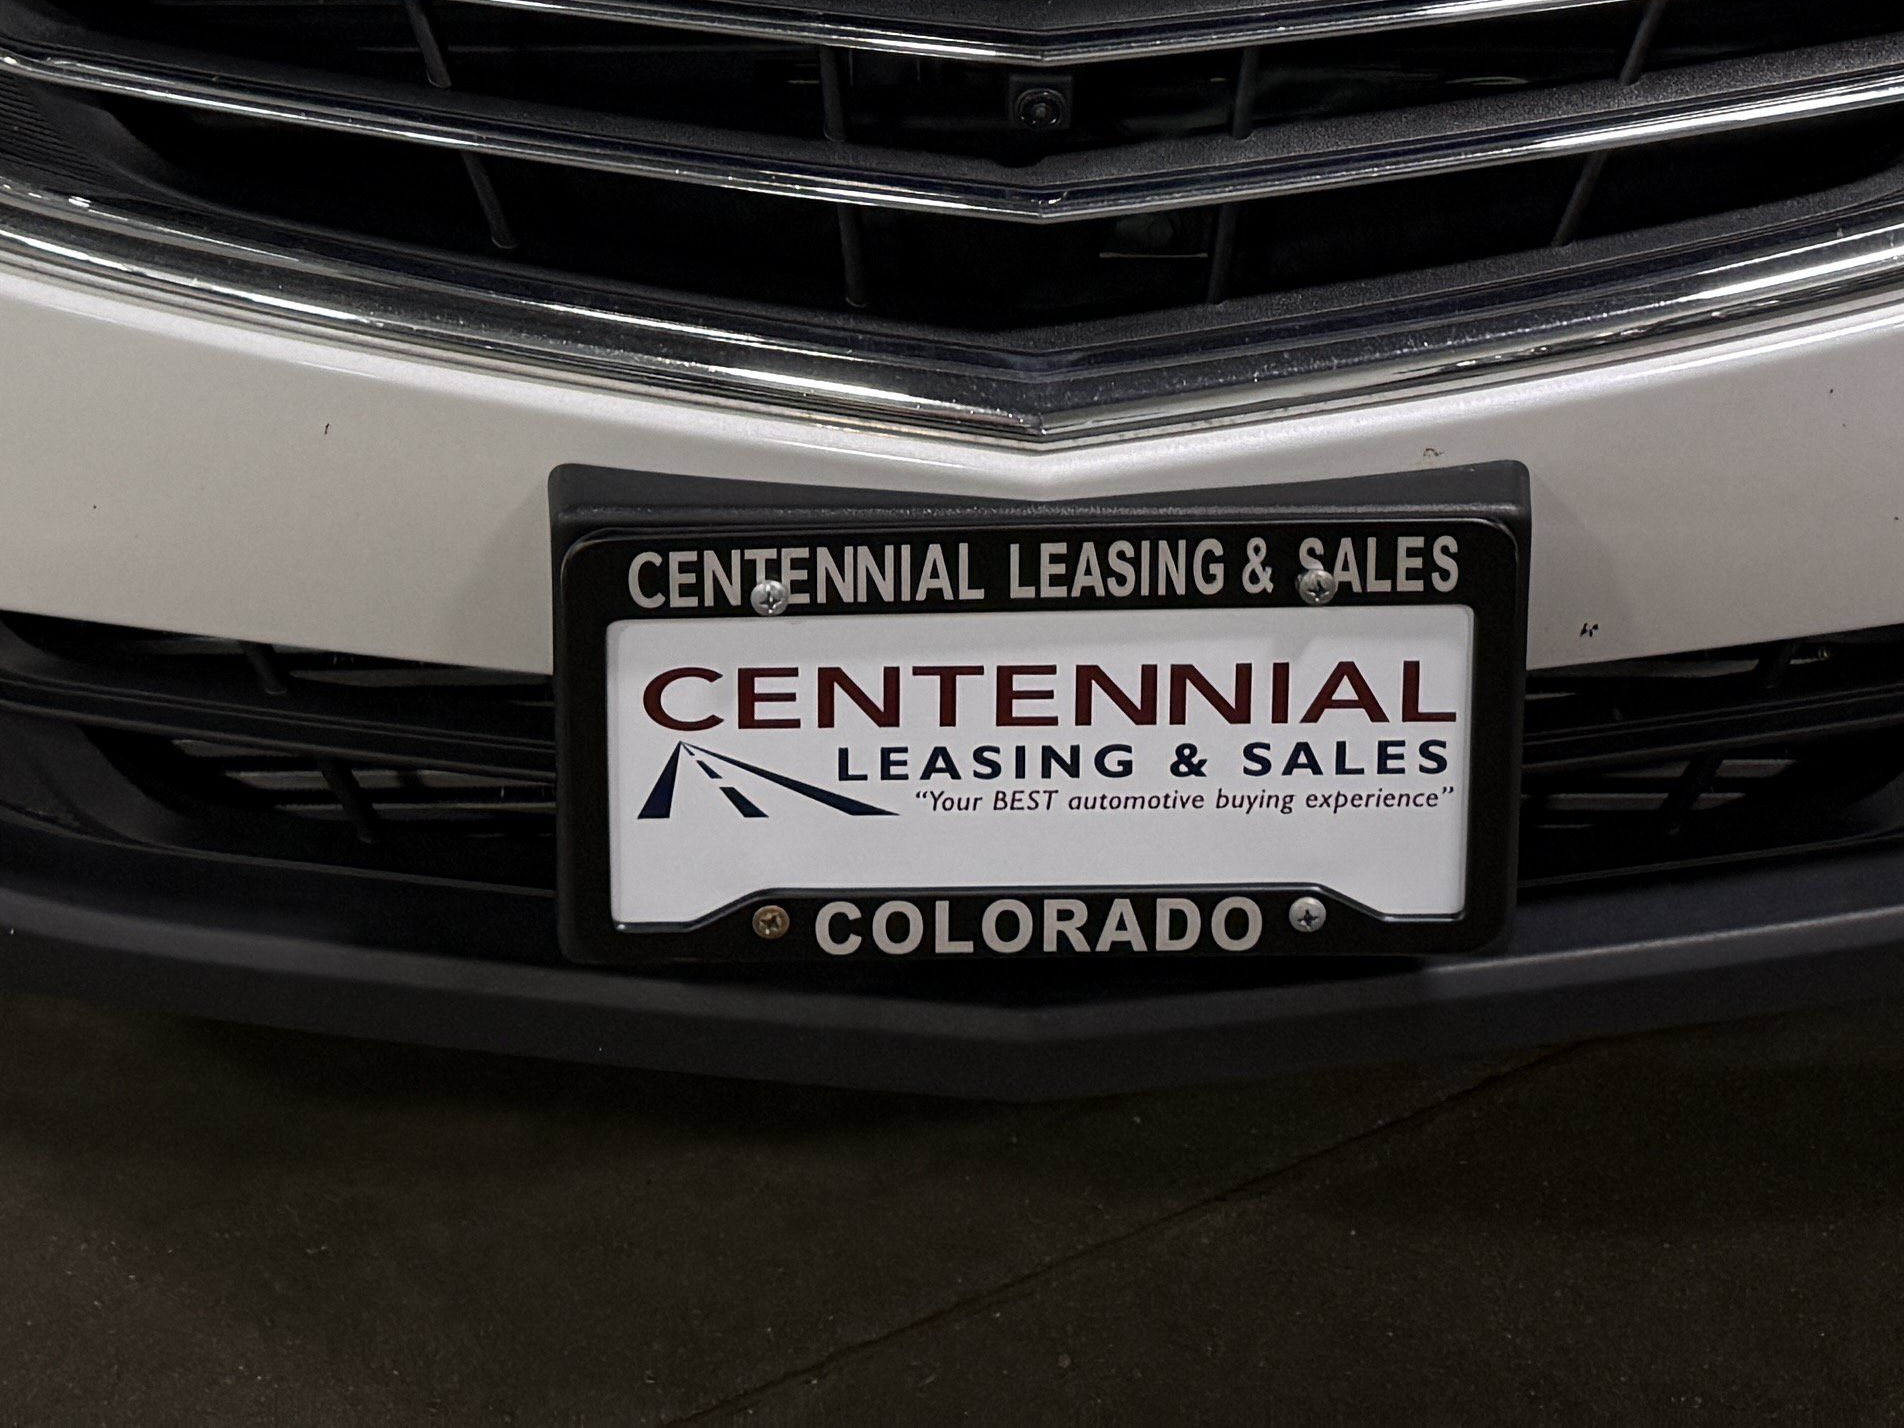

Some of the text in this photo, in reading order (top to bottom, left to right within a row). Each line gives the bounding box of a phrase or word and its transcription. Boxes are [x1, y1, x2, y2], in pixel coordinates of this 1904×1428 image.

[628, 535, 1459, 608] CENTENNIAL LEASING & SALES
[642, 659, 1457, 732] CENTENNIAL
[837, 738, 1448, 782] LEASING & SALES
[992, 789, 1059, 811] BEST
[1067, 788, 1205, 811] automotive
[1215, 787, 1296, 816] buying
[815, 896, 1263, 955] COLORADO
